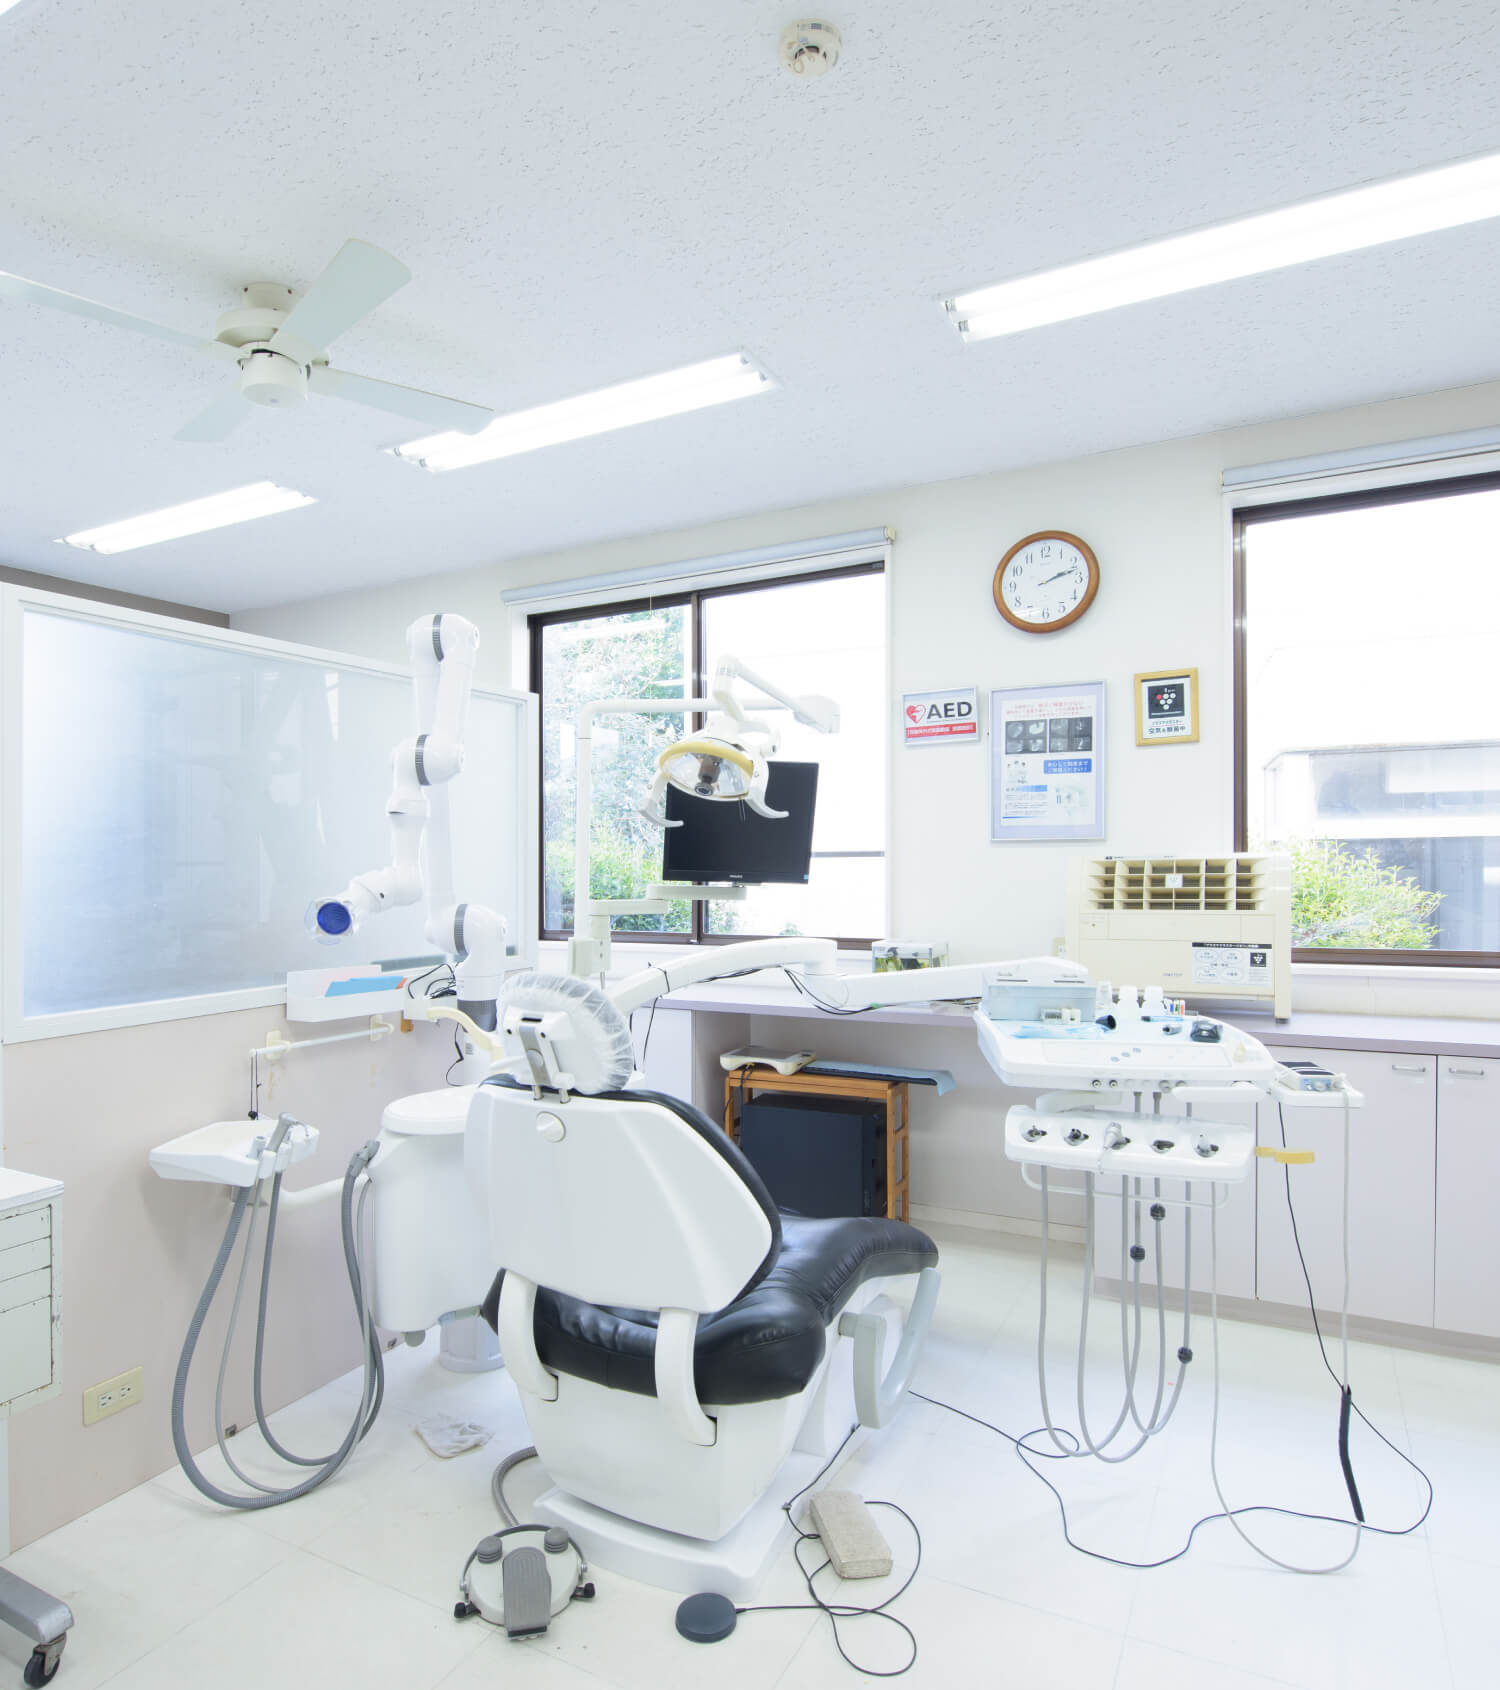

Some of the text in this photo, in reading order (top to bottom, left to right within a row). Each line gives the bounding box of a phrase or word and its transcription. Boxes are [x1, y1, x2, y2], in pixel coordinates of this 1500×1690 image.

[1025, 552, 1033, 564] 11
[1040, 545, 1051, 559] 12
[1070, 556, 1078, 568] 2
[1012, 565, 1022, 577] 10
[1074, 571, 1083, 584] 3
[1009, 580, 1017, 593] 9
[1070, 588, 1078, 601] 4
[1014, 596, 1022, 607] 8
[1058, 601, 1066, 613] 5
[1042, 607, 1050, 619] 6
[927, 701, 972, 719] AED
